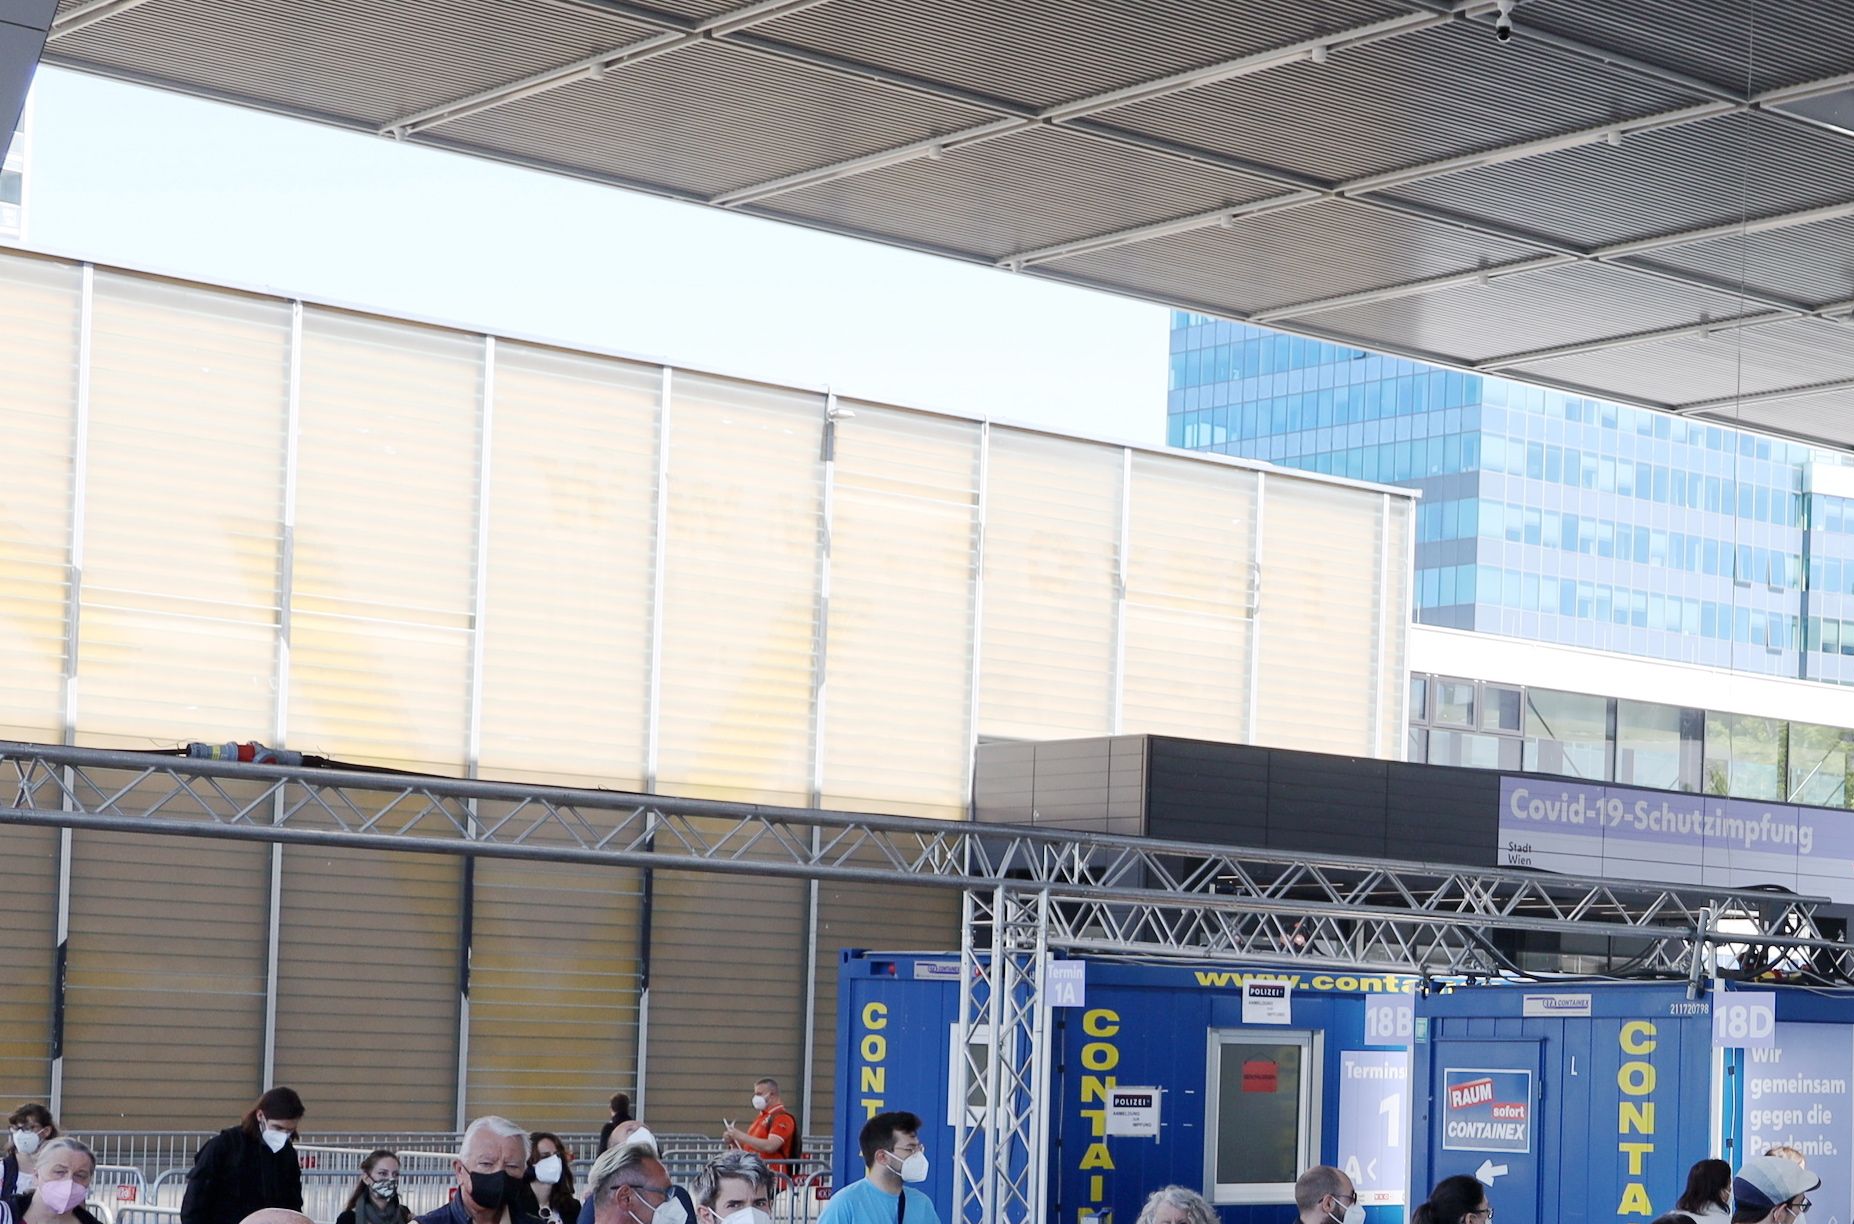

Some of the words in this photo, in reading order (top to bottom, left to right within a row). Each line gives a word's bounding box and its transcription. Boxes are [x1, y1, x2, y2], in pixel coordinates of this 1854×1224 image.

[1509, 787, 1814, 854] Covid-19-Schutzimpfung
[1508, 841, 1532, 853] Stadt
[1508, 854, 1532, 865] Wien
[1048, 963, 1084, 979] Termin
[1055, 984, 1075, 1004] 1A
[1250, 987, 1280, 997] POLIZEI
[1367, 1006, 1412, 1037] 18B
[1714, 1004, 1773, 1039] 18D
[1345, 1061, 1408, 1080] Termins
[1451, 1082, 1493, 1108] RAUM
[1751, 1072, 1846, 1100] gemeinsam
[1114, 1098, 1146, 1106] POLIZEI
[1493, 1104, 1525, 1119] sofort
[1750, 1108, 1803, 1132] gegen
[1806, 1104, 1832, 1125] die
[1447, 1120, 1527, 1141] CONTAINEX
